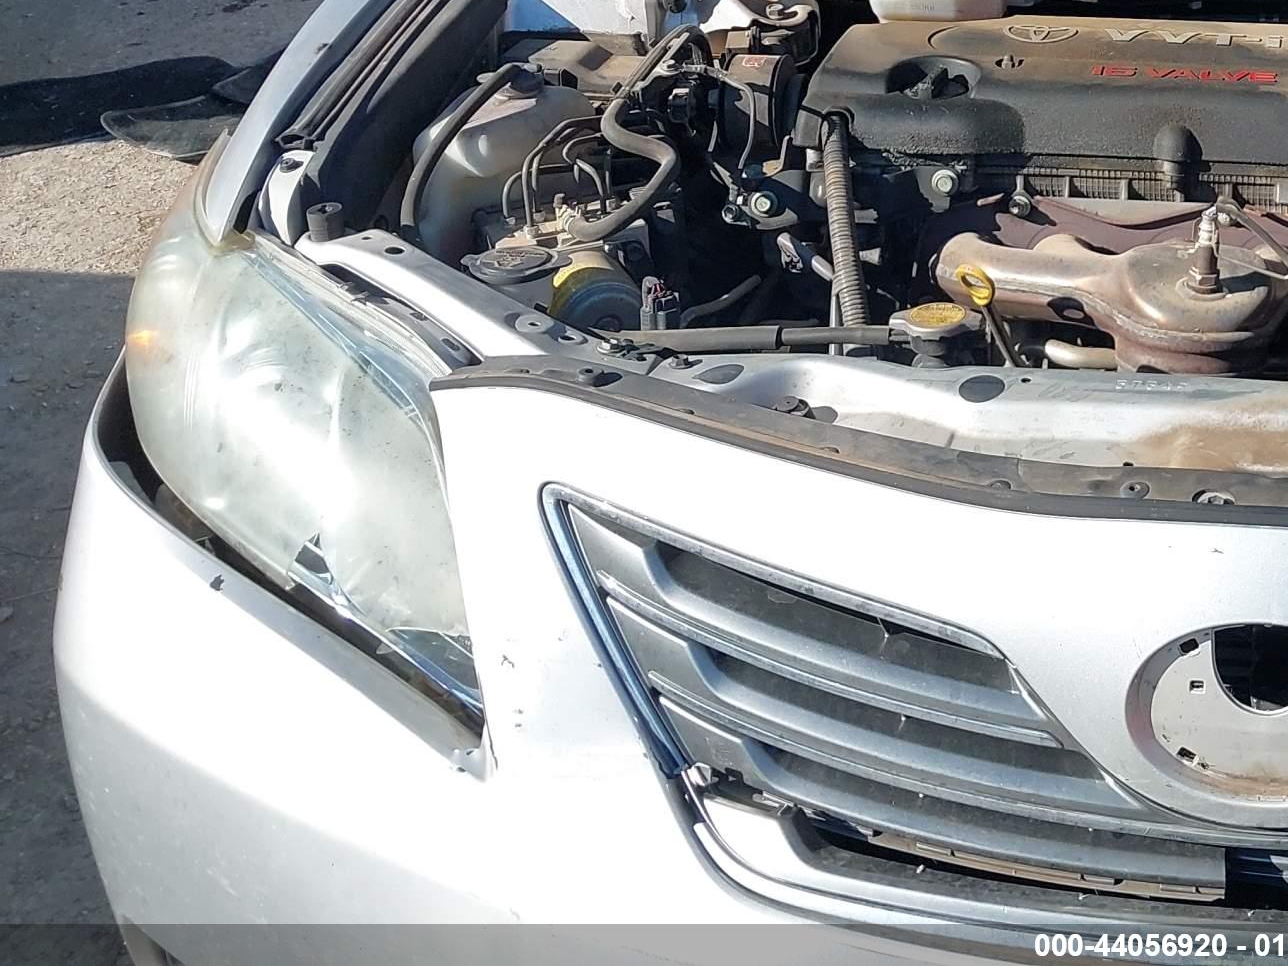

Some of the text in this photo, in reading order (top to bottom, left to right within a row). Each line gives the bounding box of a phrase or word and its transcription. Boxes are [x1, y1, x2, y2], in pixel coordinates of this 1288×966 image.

[1103, 28, 1284, 49] VVT-i
[1091, 65, 1279, 83] 16 VALVE
